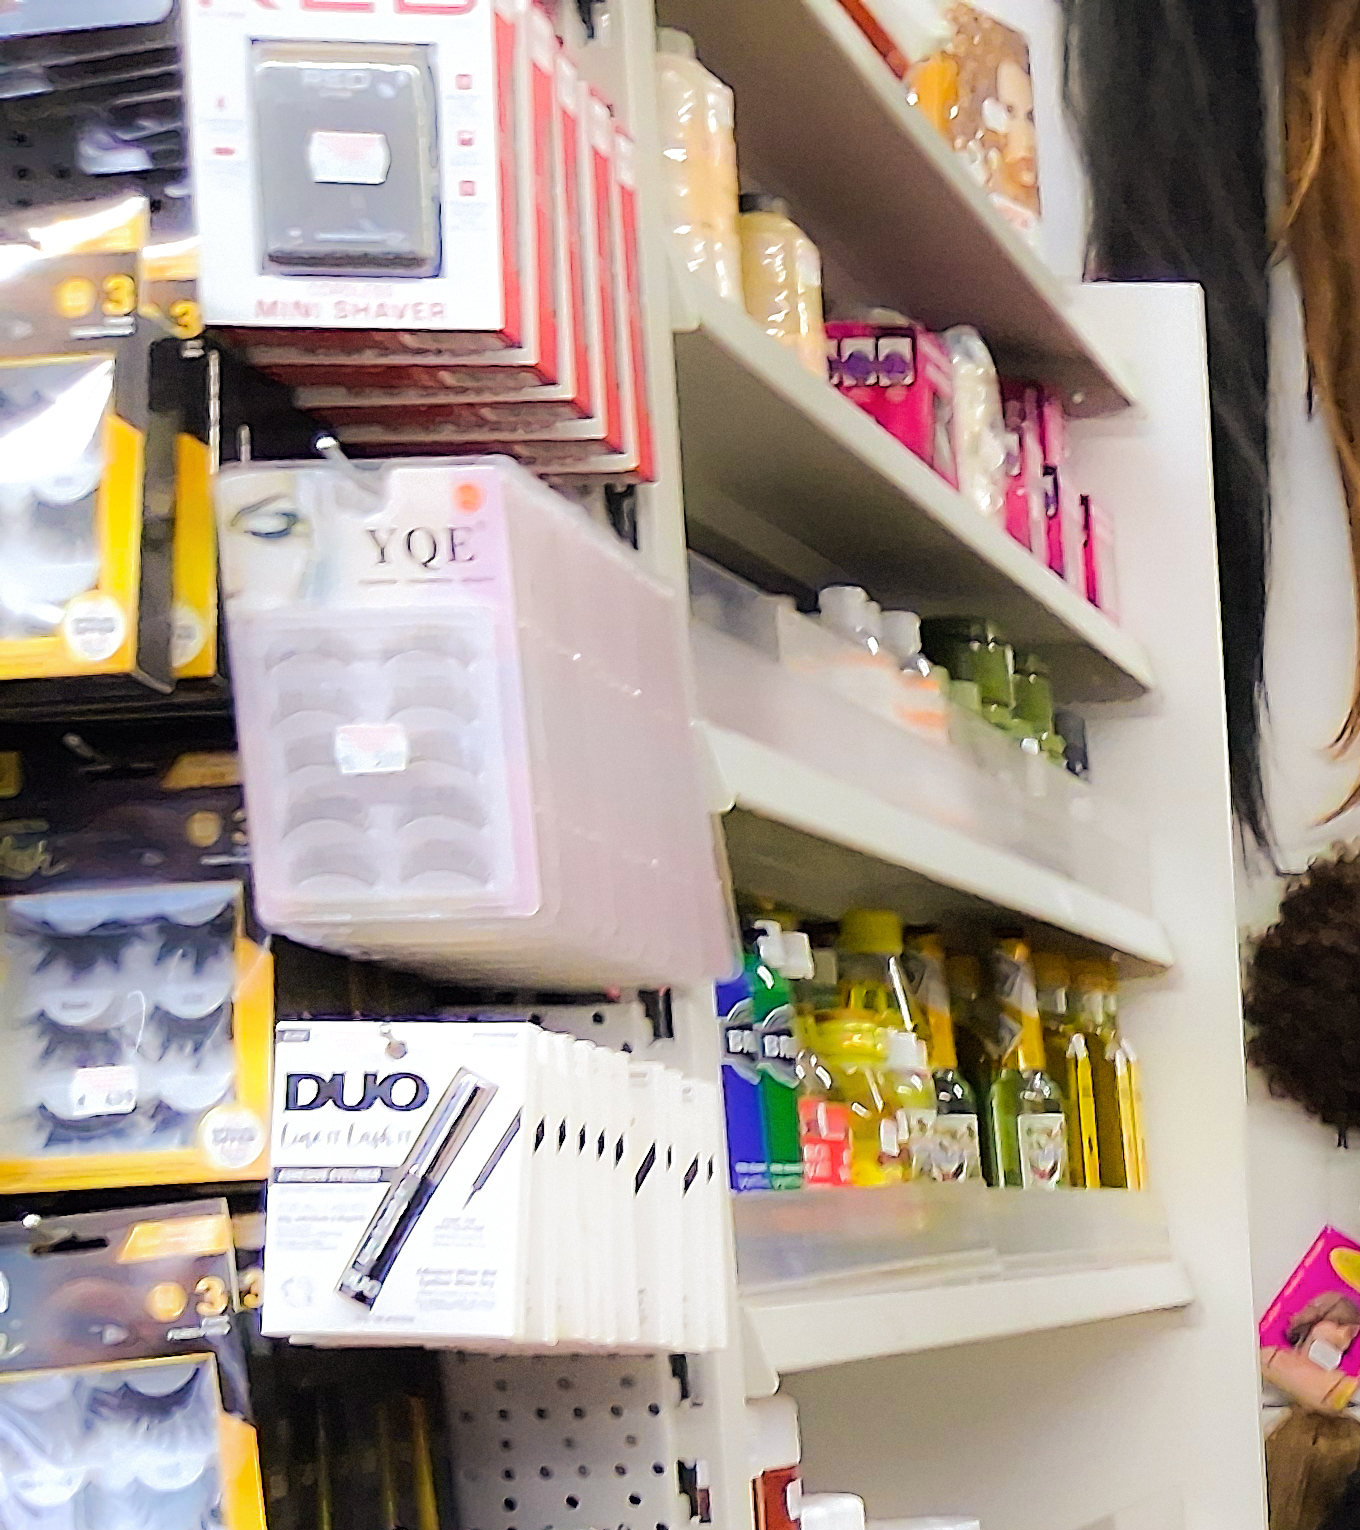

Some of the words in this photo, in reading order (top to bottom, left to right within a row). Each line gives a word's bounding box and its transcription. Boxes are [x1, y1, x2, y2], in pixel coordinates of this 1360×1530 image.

[102, 274, 136, 317] 3
[333, 300, 446, 320] SHAVER
[365, 525, 475, 570] YQE
[284, 1072, 430, 1113] DUO
[195, 1276, 228, 1316] 3
